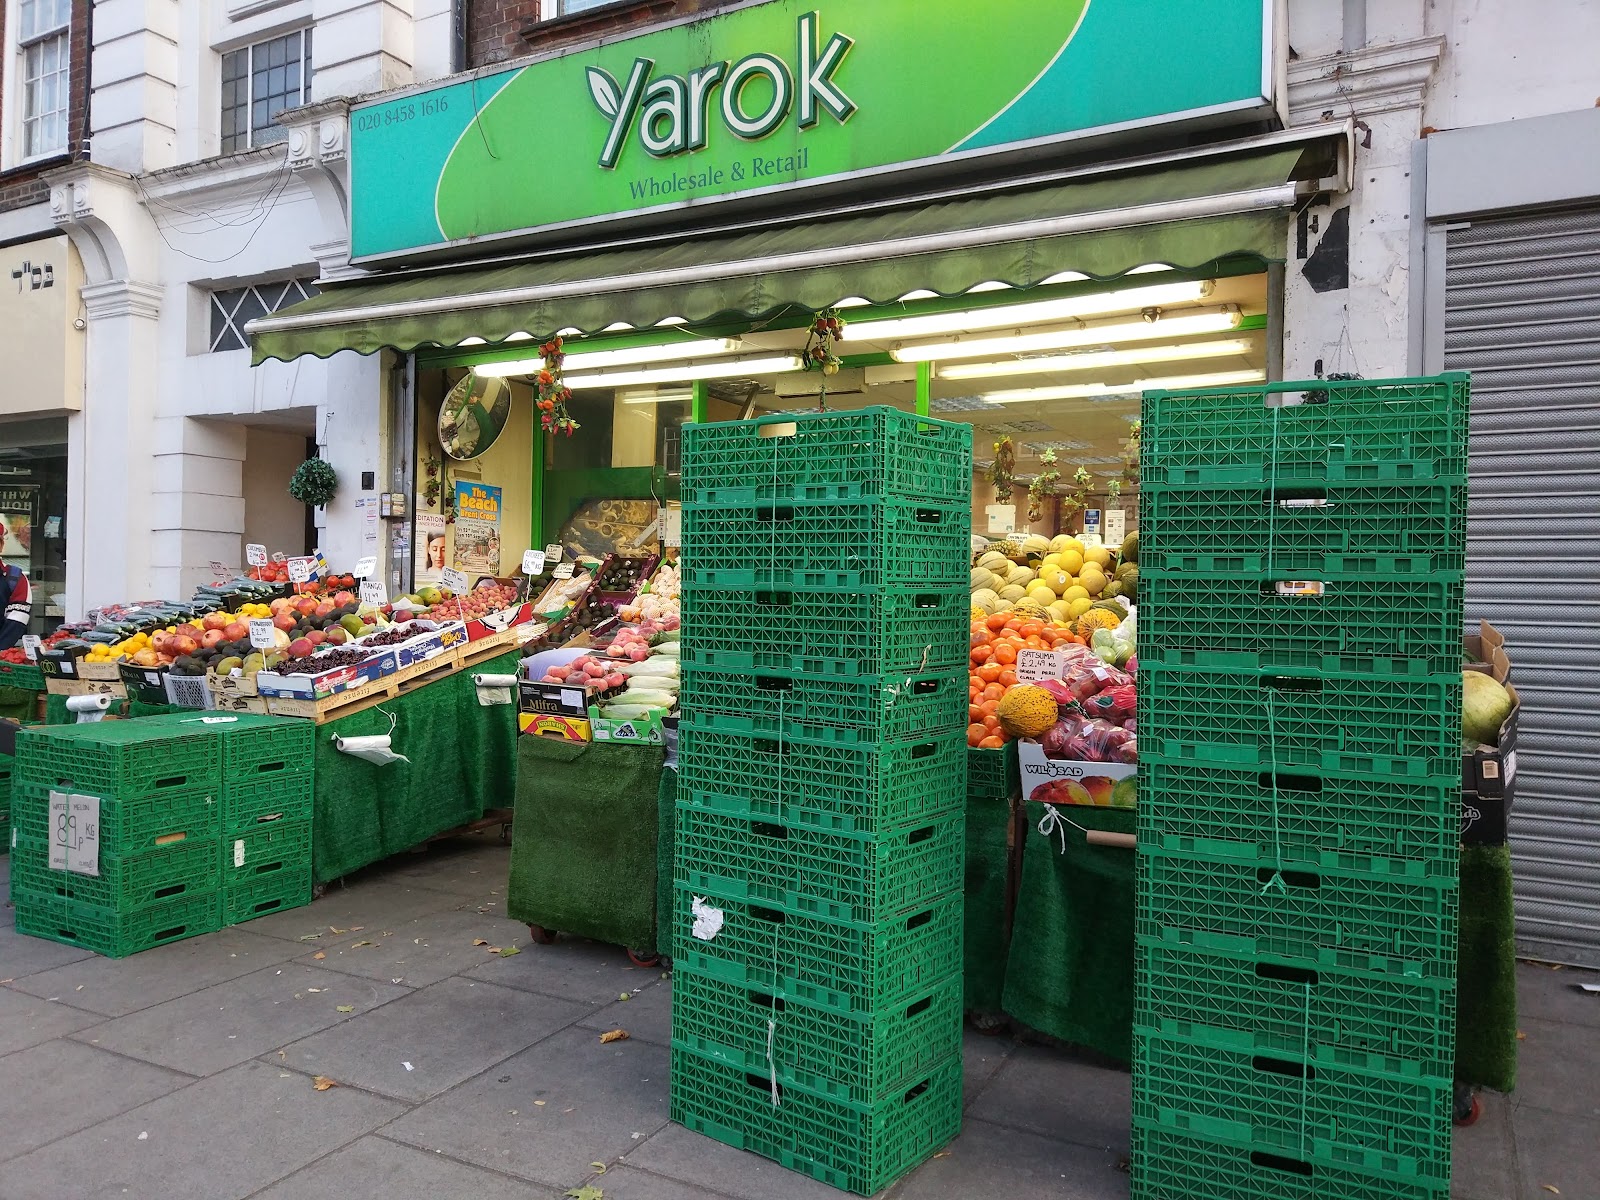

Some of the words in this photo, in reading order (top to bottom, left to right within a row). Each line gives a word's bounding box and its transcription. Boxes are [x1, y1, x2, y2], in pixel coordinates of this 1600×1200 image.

[358, 116, 381, 132] 020
[384, 104, 416, 126] 8458
[421, 96, 449, 117] 1616
[629, 167, 724, 200] Wholesale
[730, 161, 746, 182] &
[752, 147, 808, 178] Retail
[472, 486, 487, 499] The
[460, 492, 498, 512] Beach
[460, 509, 478, 519] Brent
[479, 511, 497, 522] Cross
[363, 582, 383, 590] MANGO
[1021, 650, 1055, 660] SATSUMA
[1021, 657, 1046, 668] £2.49
[528, 698, 559, 713] Mifra
[85, 822, 95, 837] KG
